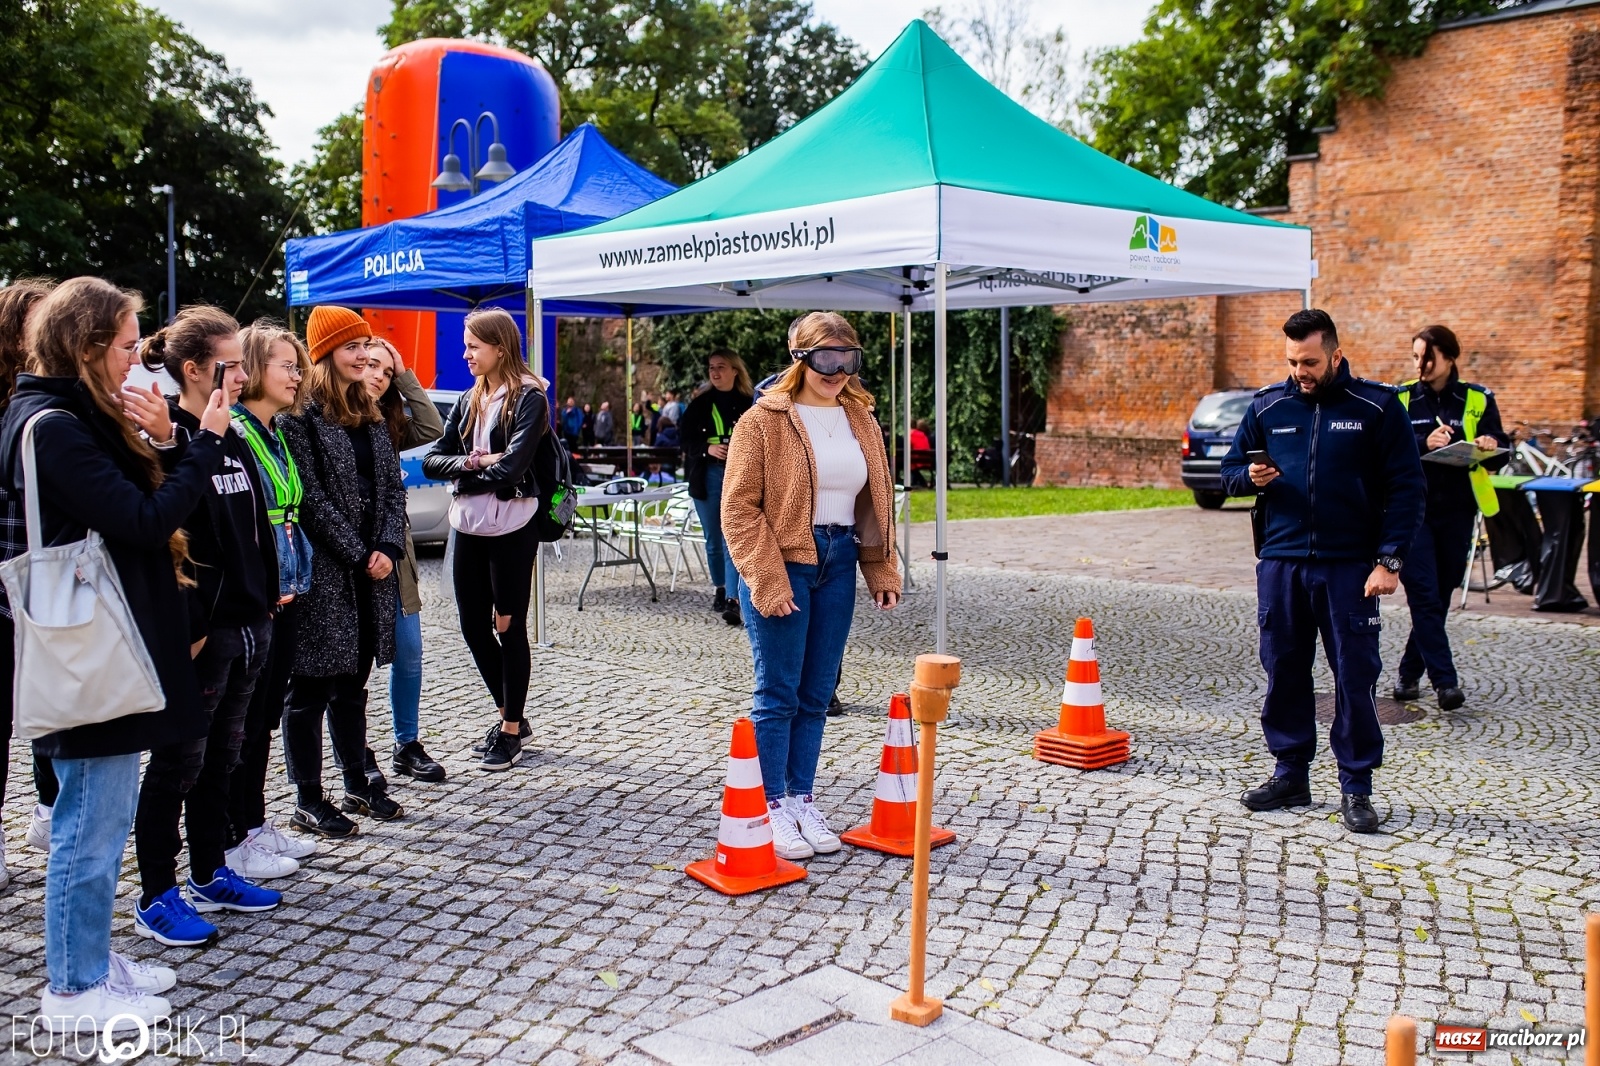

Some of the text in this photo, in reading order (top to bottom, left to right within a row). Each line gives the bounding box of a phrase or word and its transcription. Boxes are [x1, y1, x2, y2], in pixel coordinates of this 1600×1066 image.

[599, 216, 835, 269] www.zamekpiastowski.pl
[364, 249, 425, 279] POLICJA
[1129, 254, 1151, 263] powiat
[1330, 421, 1363, 431] POLICJA
